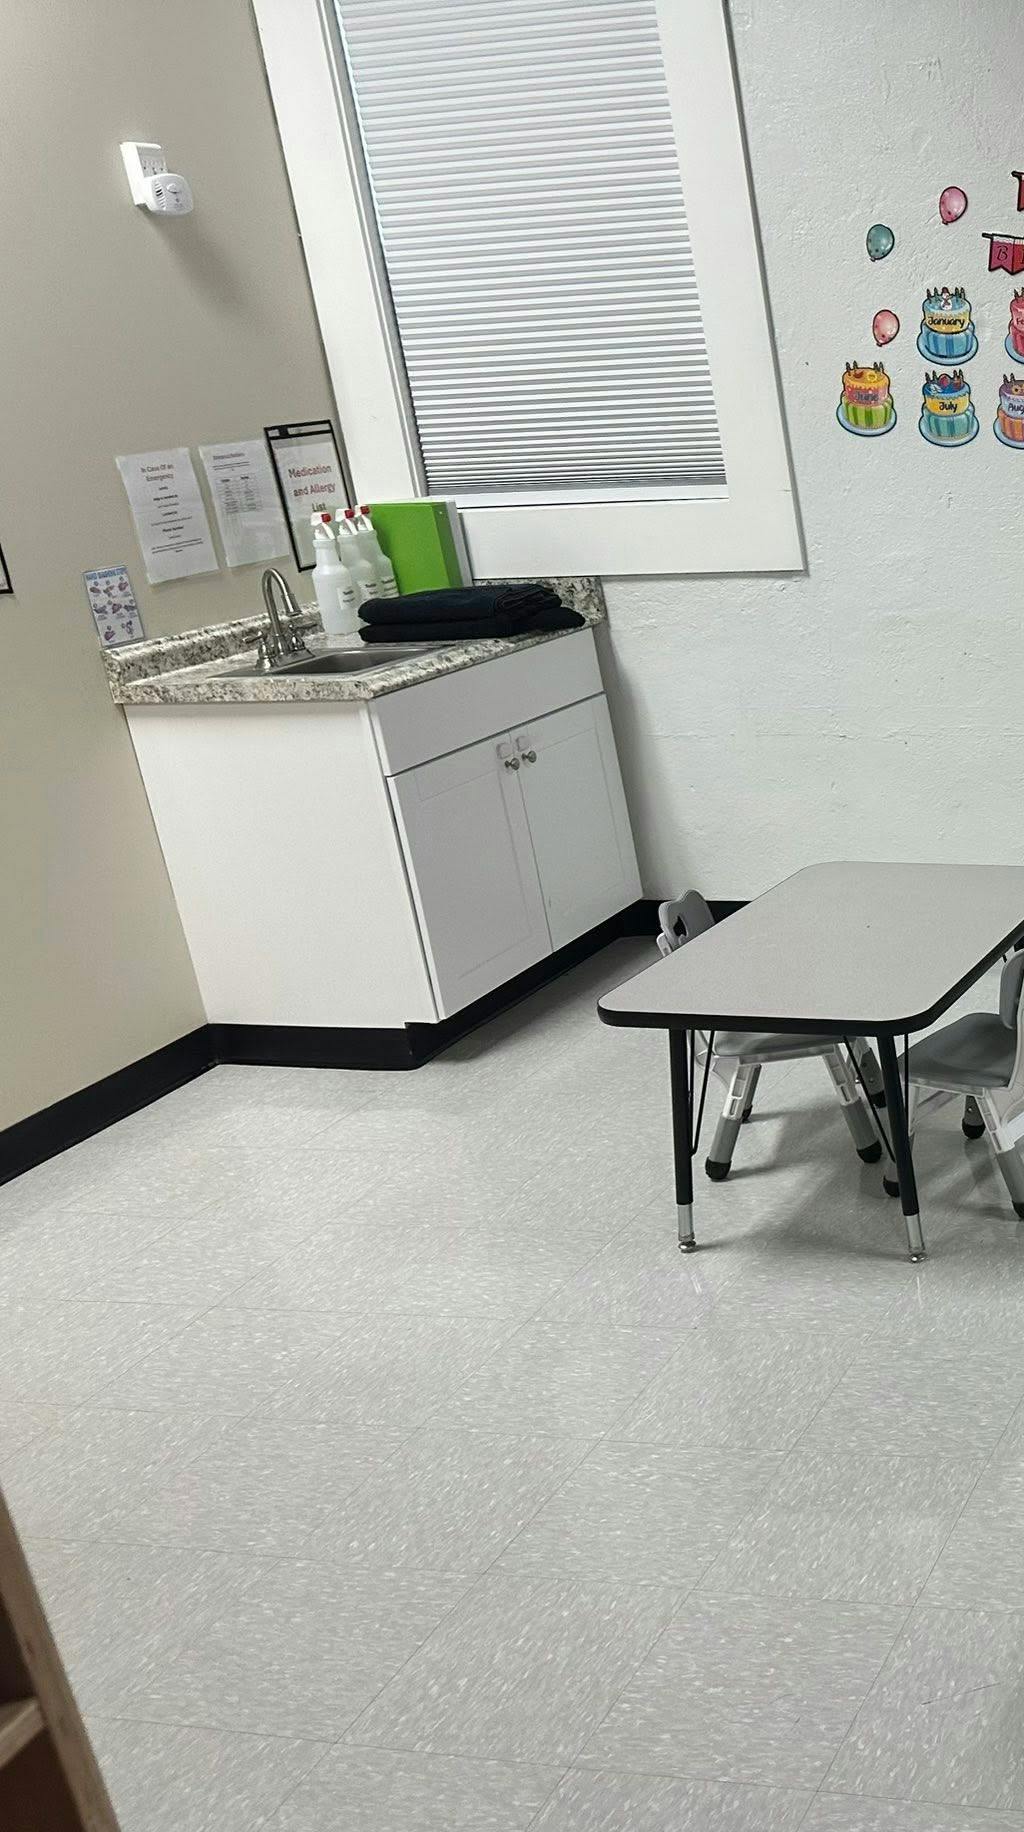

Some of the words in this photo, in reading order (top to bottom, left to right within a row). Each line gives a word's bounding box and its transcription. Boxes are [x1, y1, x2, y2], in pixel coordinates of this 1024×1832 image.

[927, 316, 965, 328] January
[939, 402, 958, 413] July
[288, 465, 332, 478] Medication
[293, 486, 309, 497] and
[310, 483, 336, 495] Allergy
[311, 503, 327, 513] List
